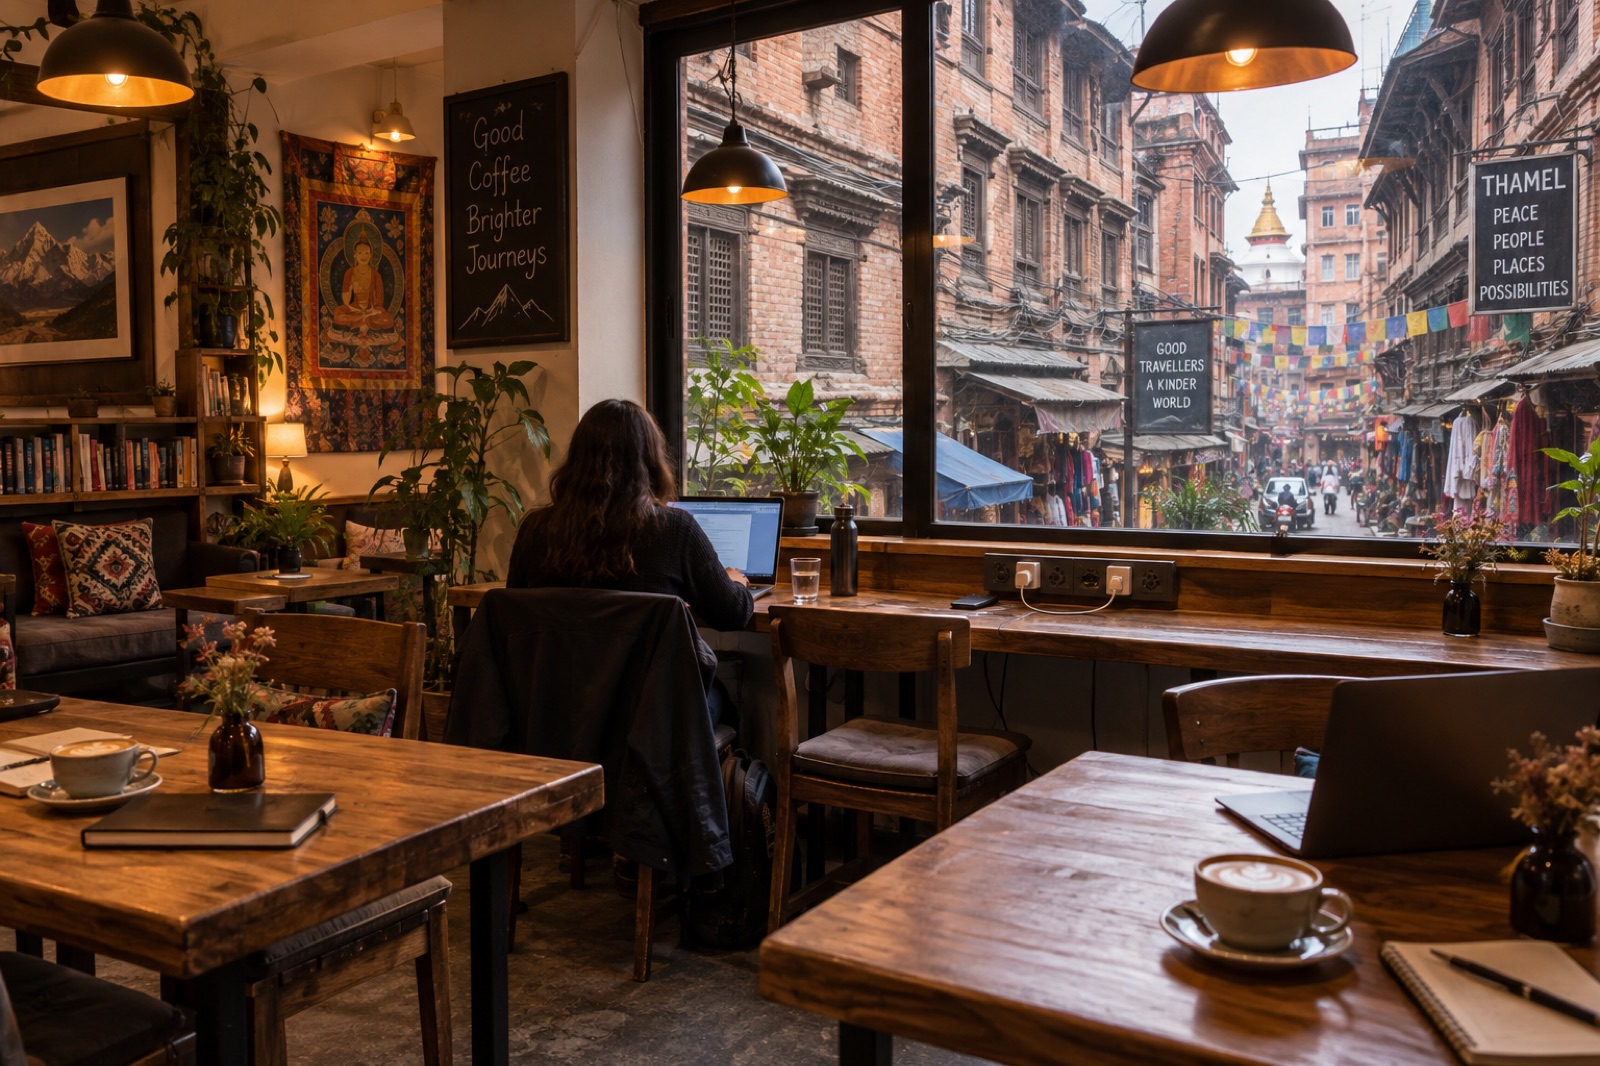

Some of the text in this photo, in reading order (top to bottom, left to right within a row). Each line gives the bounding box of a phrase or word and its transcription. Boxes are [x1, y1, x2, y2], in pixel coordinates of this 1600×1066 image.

[473, 109, 524, 153] Good
[469, 155, 531, 197] Coffee
[1481, 167, 1566, 197] THAMEL
[466, 199, 542, 243] Brighter
[1493, 204, 1539, 225] PEACE
[1493, 230, 1545, 250] PEOPLE
[466, 244, 547, 280] Journeys
[1493, 255, 1545, 275] PLACES
[1480, 280, 1569, 301] POSSIBILITIES
[1156, 342, 1187, 355] GOOD
[1139, 359, 1205, 373] TRAVELLERS
[1146, 377, 1197, 391] A KINDER
[1152, 396, 1191, 408] WORLD
